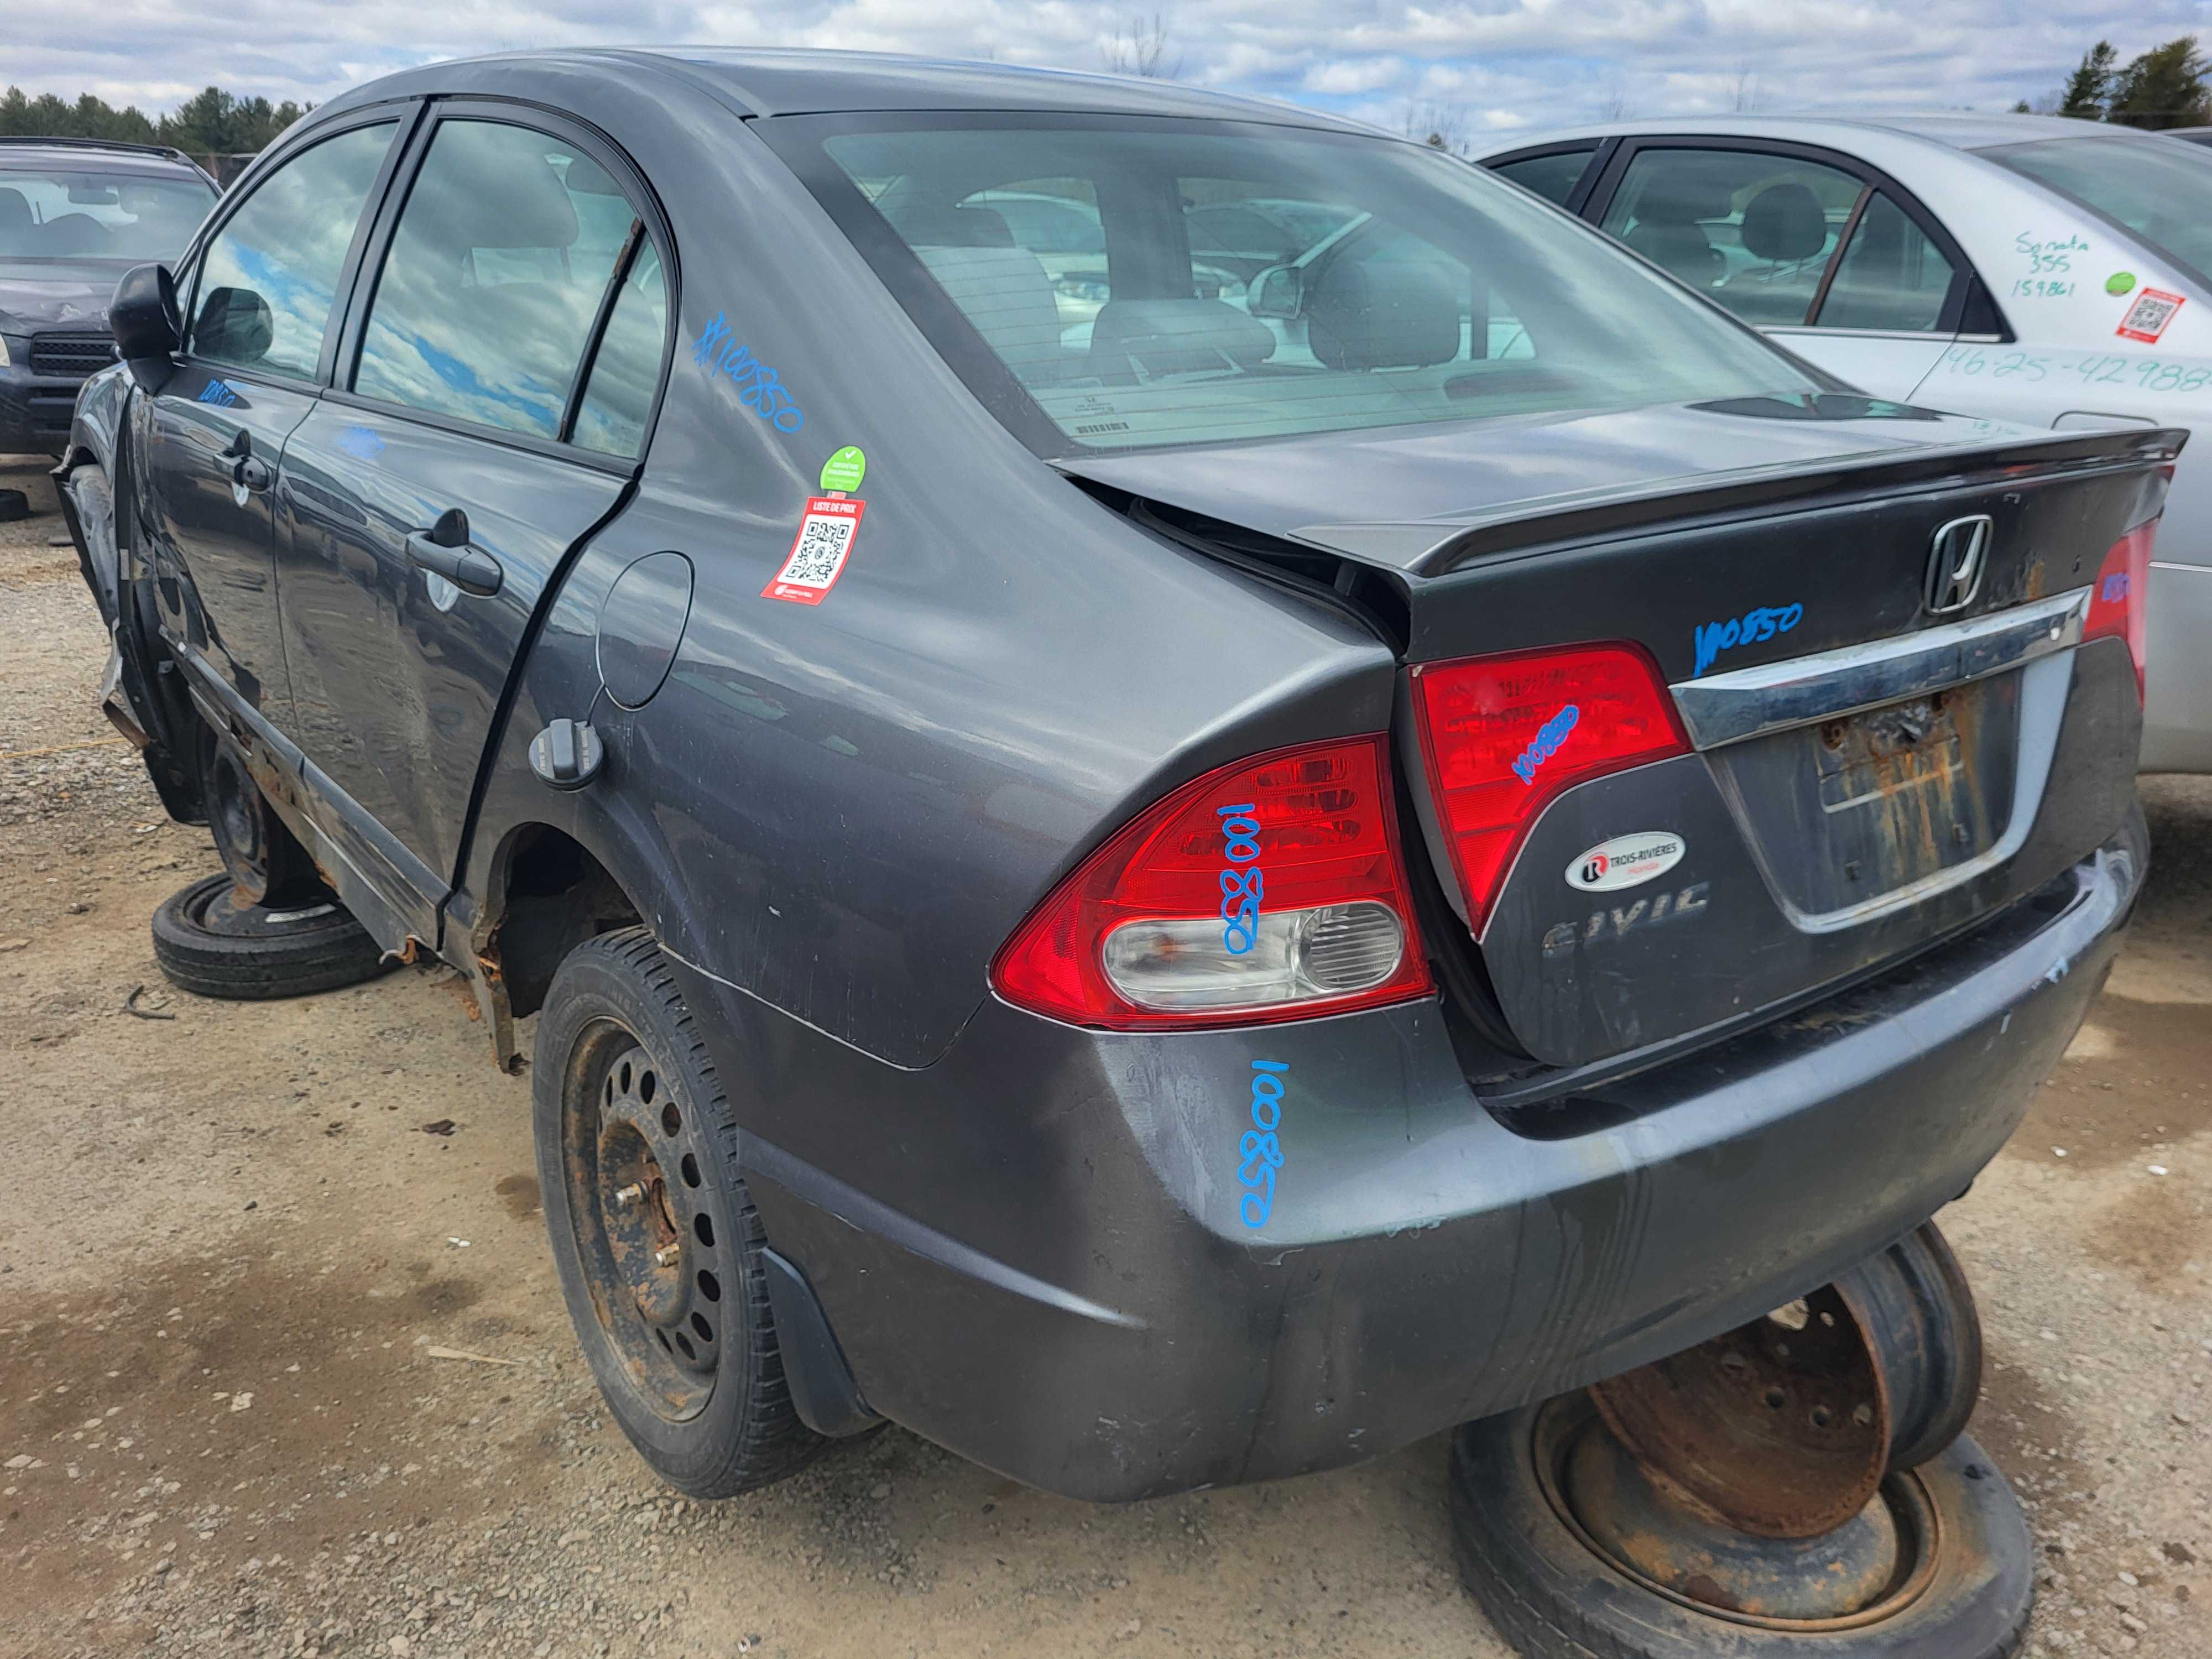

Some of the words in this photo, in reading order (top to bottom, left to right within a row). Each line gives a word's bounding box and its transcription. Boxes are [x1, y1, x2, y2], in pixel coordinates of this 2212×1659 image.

[2030, 254, 2070, 274] 355
[813, 501, 831, 512] LISTE
[830, 502, 839, 513] DE
[1217, 803, 1263, 955] 100850
[1237, 1060, 1290, 1229] 100850
